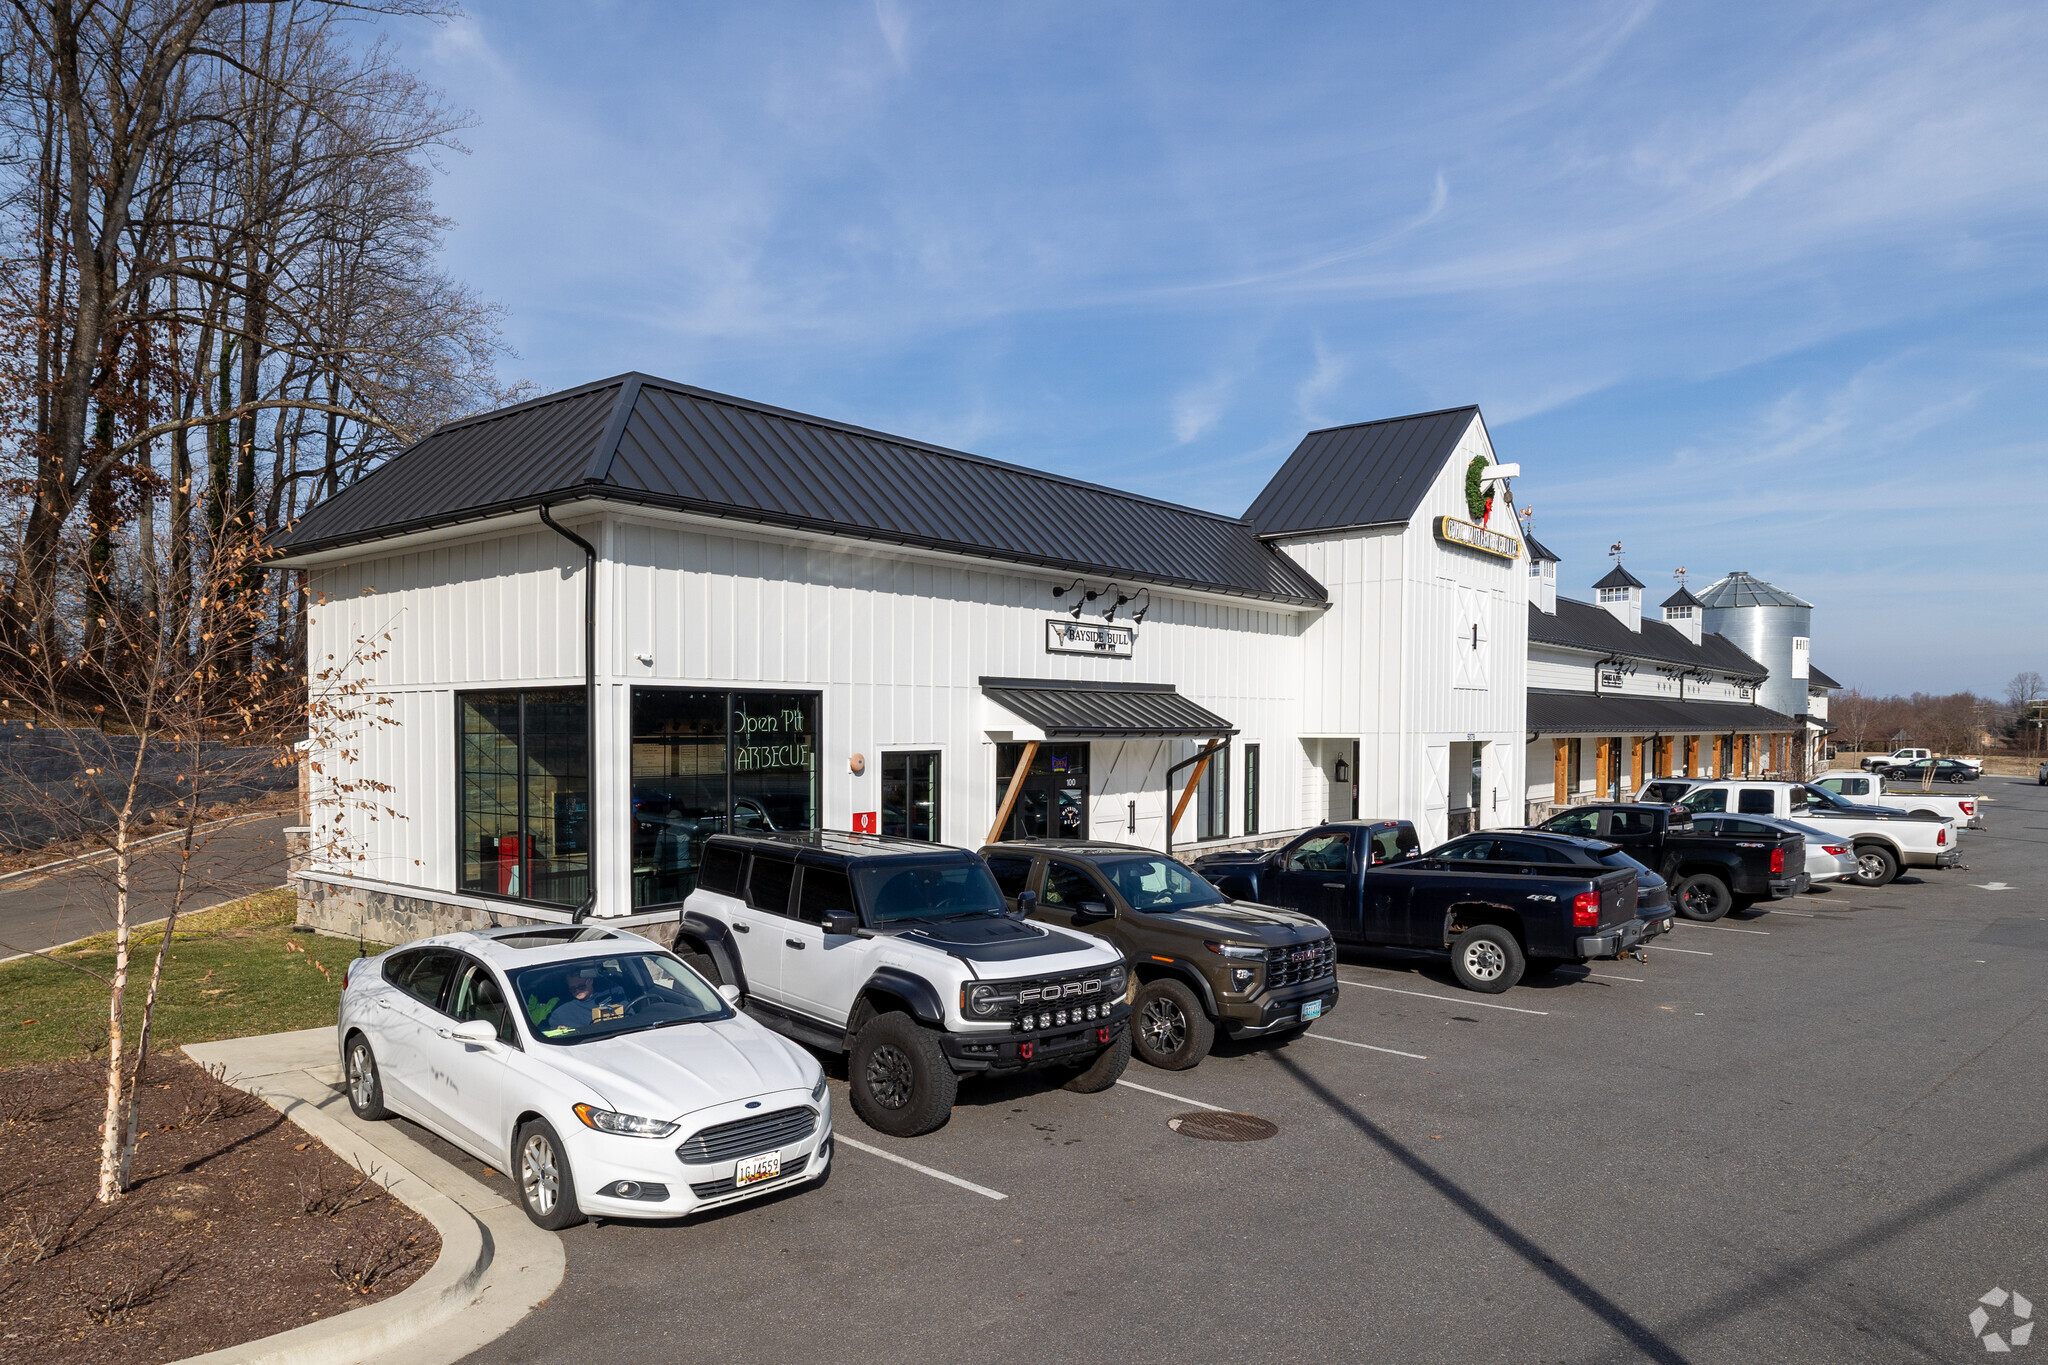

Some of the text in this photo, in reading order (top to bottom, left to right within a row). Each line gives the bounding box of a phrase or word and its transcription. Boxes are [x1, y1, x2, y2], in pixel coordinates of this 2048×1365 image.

[1069, 629, 1129, 645] BAYSIDE BULL
[736, 744, 809, 769] ARBECUE
[1066, 778, 1076, 786] 100
[1292, 948, 1323, 962] GMC
[1020, 979, 1102, 1004] FORD
